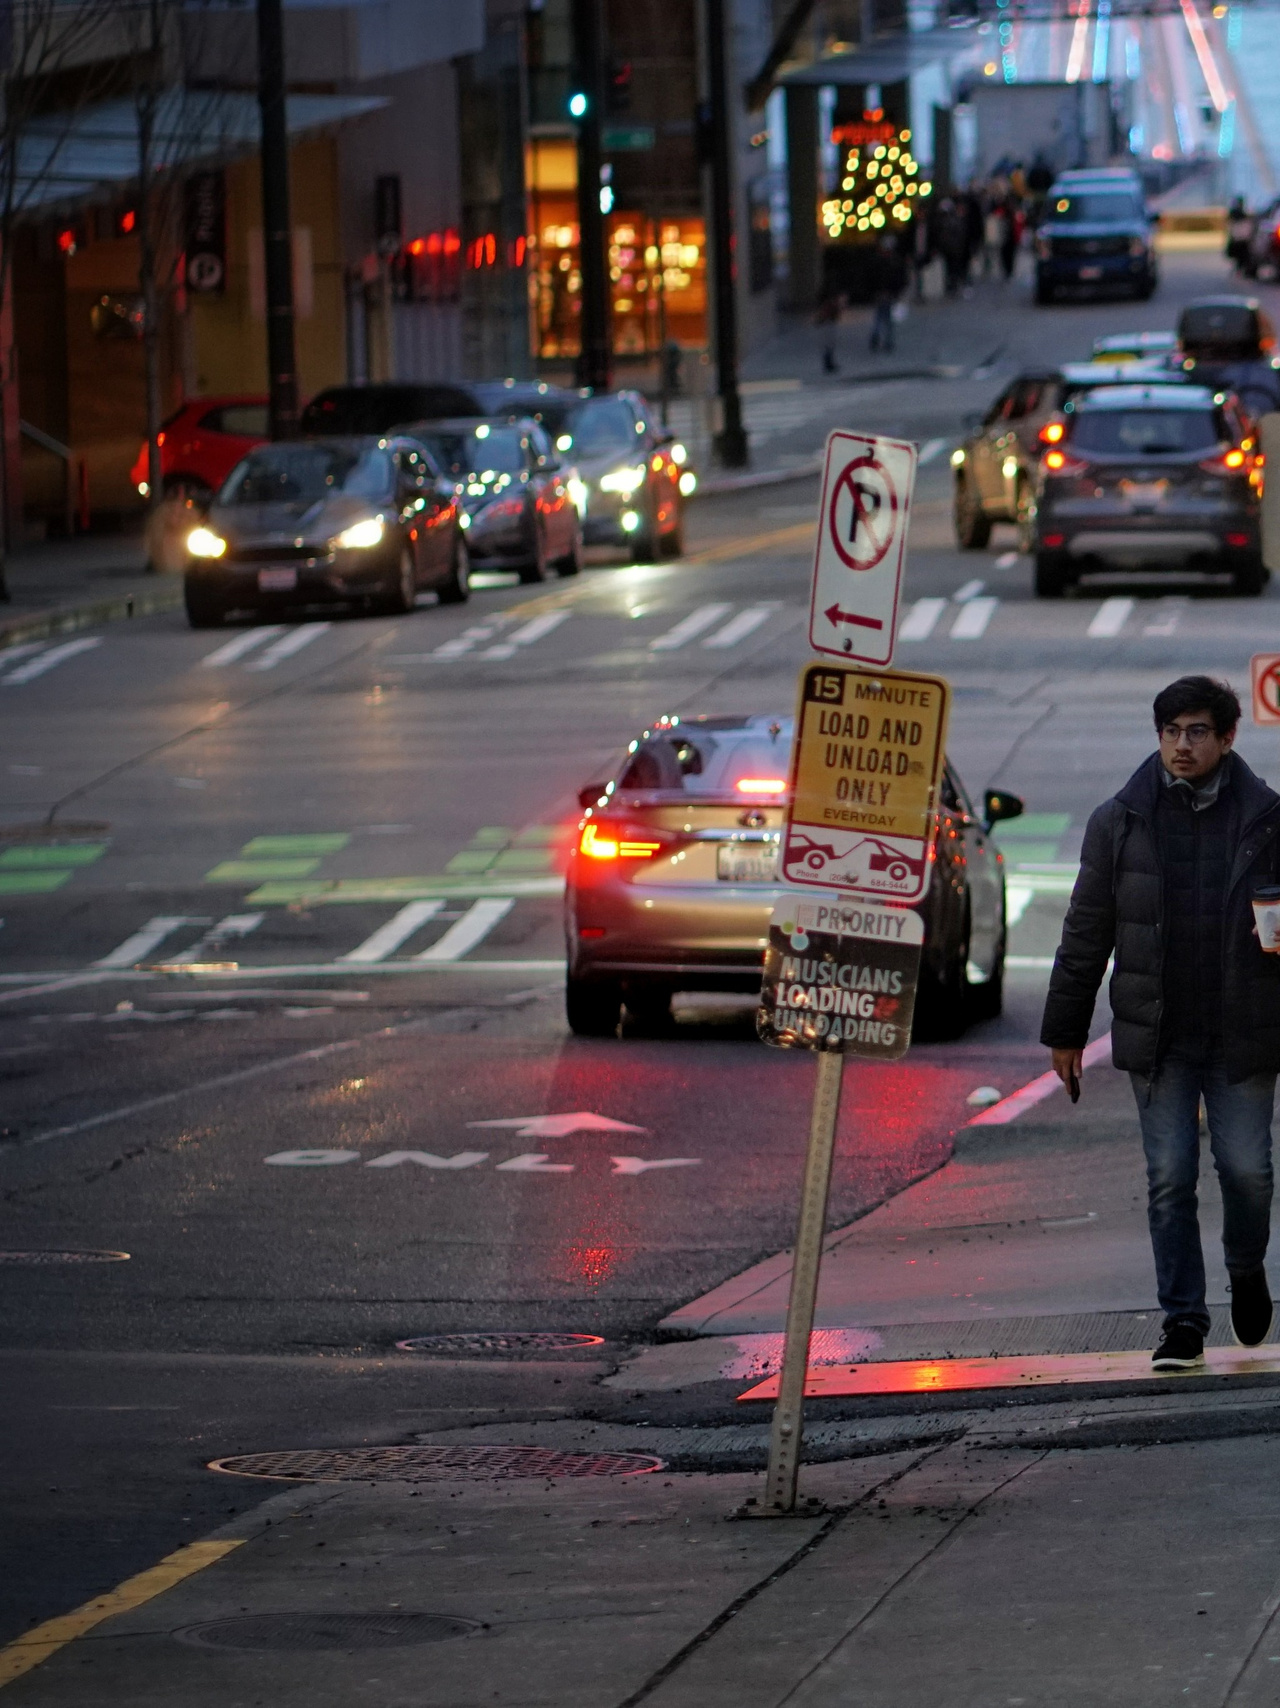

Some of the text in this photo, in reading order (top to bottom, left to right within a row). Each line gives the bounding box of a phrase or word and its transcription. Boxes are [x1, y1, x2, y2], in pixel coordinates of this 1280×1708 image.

[813, 675, 842, 700] 15
[819, 710, 923, 746] LOAD AND
[825, 743, 909, 776] UNLOAD
[836, 776, 892, 807] ONLY
[823, 808, 898, 827] EVERYDAY
[796, 869, 819, 880] Phone
[870, 879, 909, 891] 684-5444
[779, 956, 903, 995] MUSICIANS
[776, 982, 875, 1018] LOADING
[263, 1149, 701, 1175] ONLY
